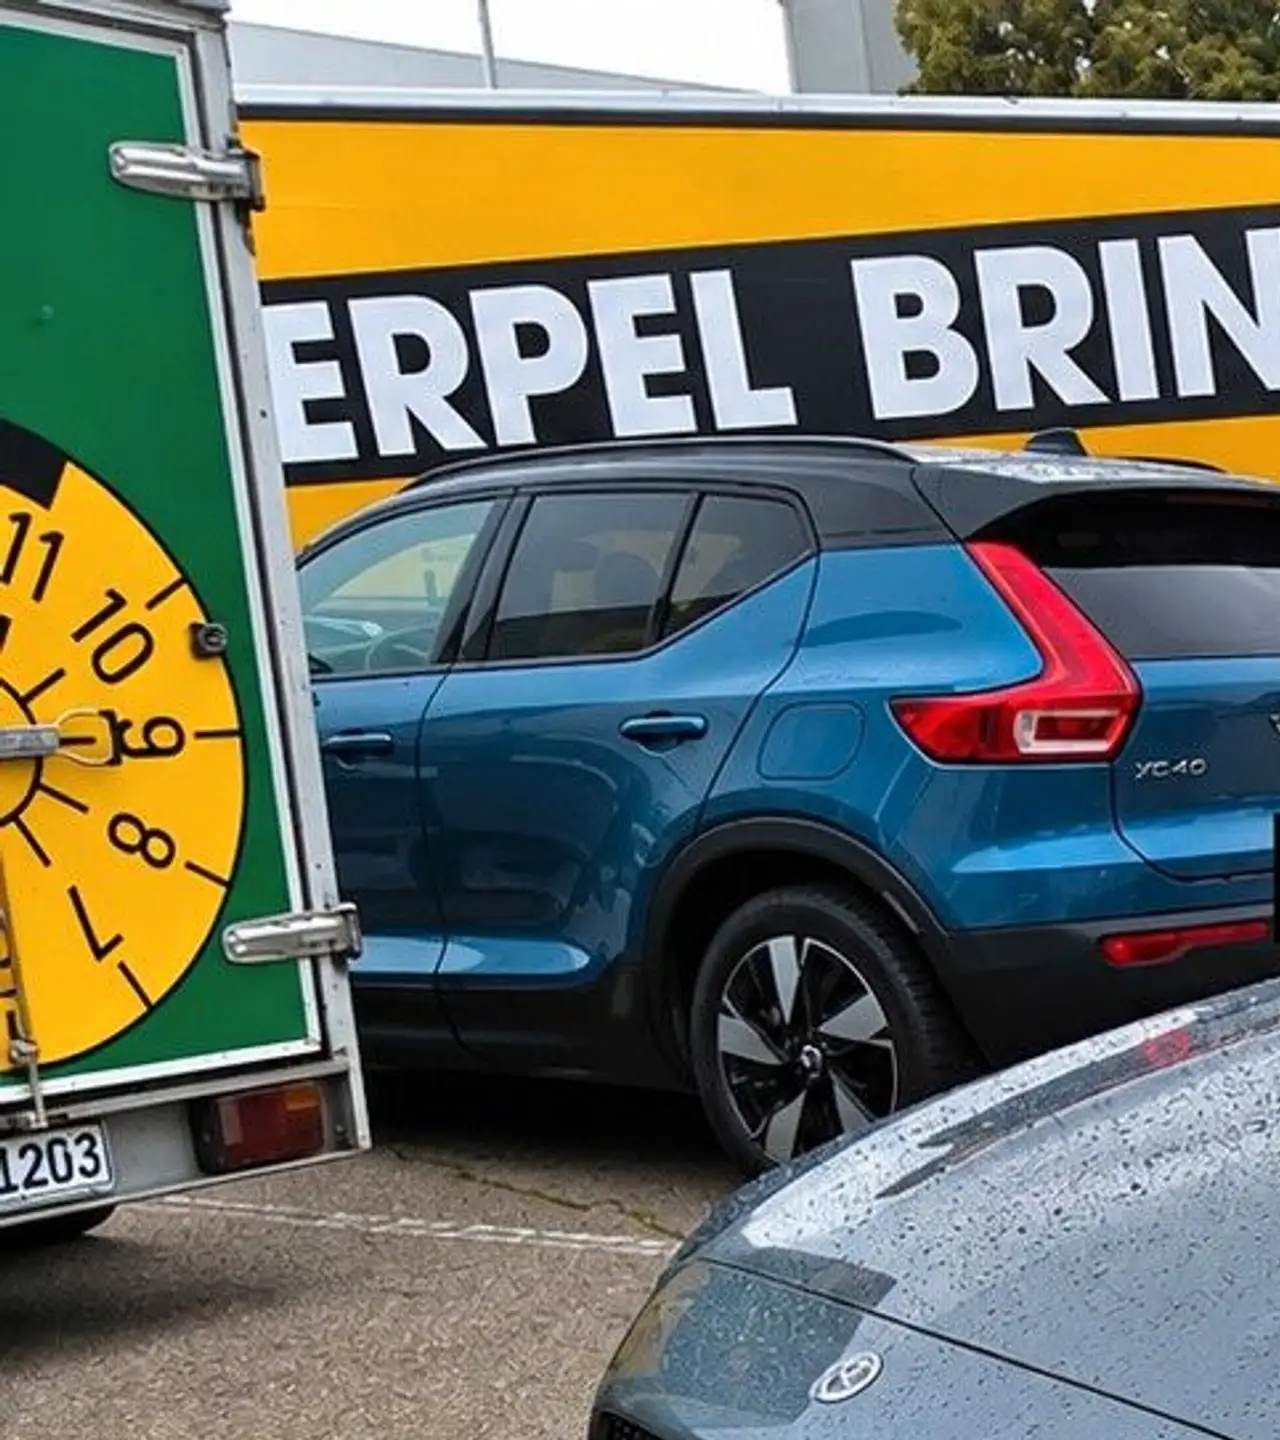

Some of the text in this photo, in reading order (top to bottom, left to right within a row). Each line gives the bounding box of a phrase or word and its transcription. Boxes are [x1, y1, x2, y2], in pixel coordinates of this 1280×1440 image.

[261, 269, 798, 464] ERPEL
[0, 511, 65, 603] 11
[70, 587, 155, 685] 10
[1134, 758, 1208, 779] XC40
[106, 812, 177, 869] 8
[68, 884, 124, 962] 7
